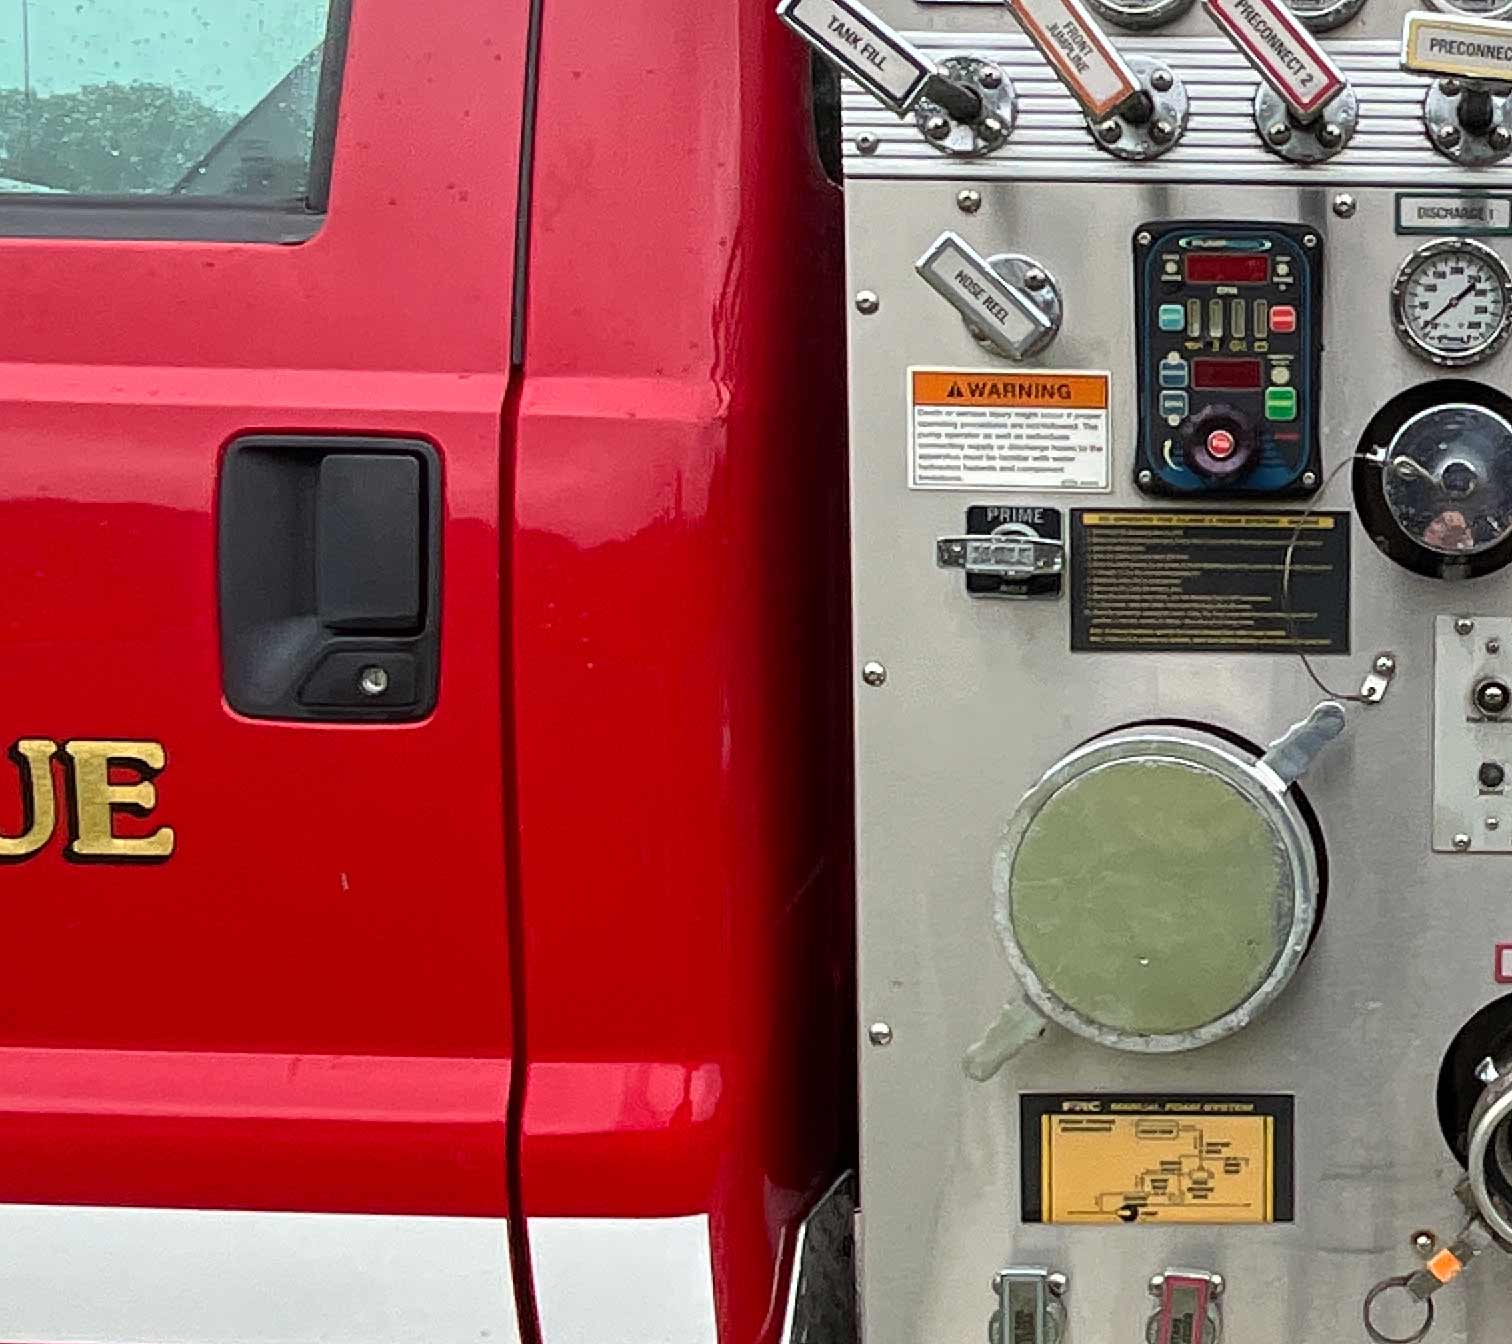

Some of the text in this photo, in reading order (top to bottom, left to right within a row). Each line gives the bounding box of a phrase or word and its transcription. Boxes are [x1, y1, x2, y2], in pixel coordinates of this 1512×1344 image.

[826, 13, 887, 73] TANK FILL
[1063, 19, 1095, 57] FRONT
[1299, 72, 1315, 89] 2
[1417, 207, 1484, 221] DISCHARGE
[954, 268, 1009, 327] HOSE REEL
[967, 381, 1072, 400] WARNING
[986, 506, 1045, 523] PRIME
